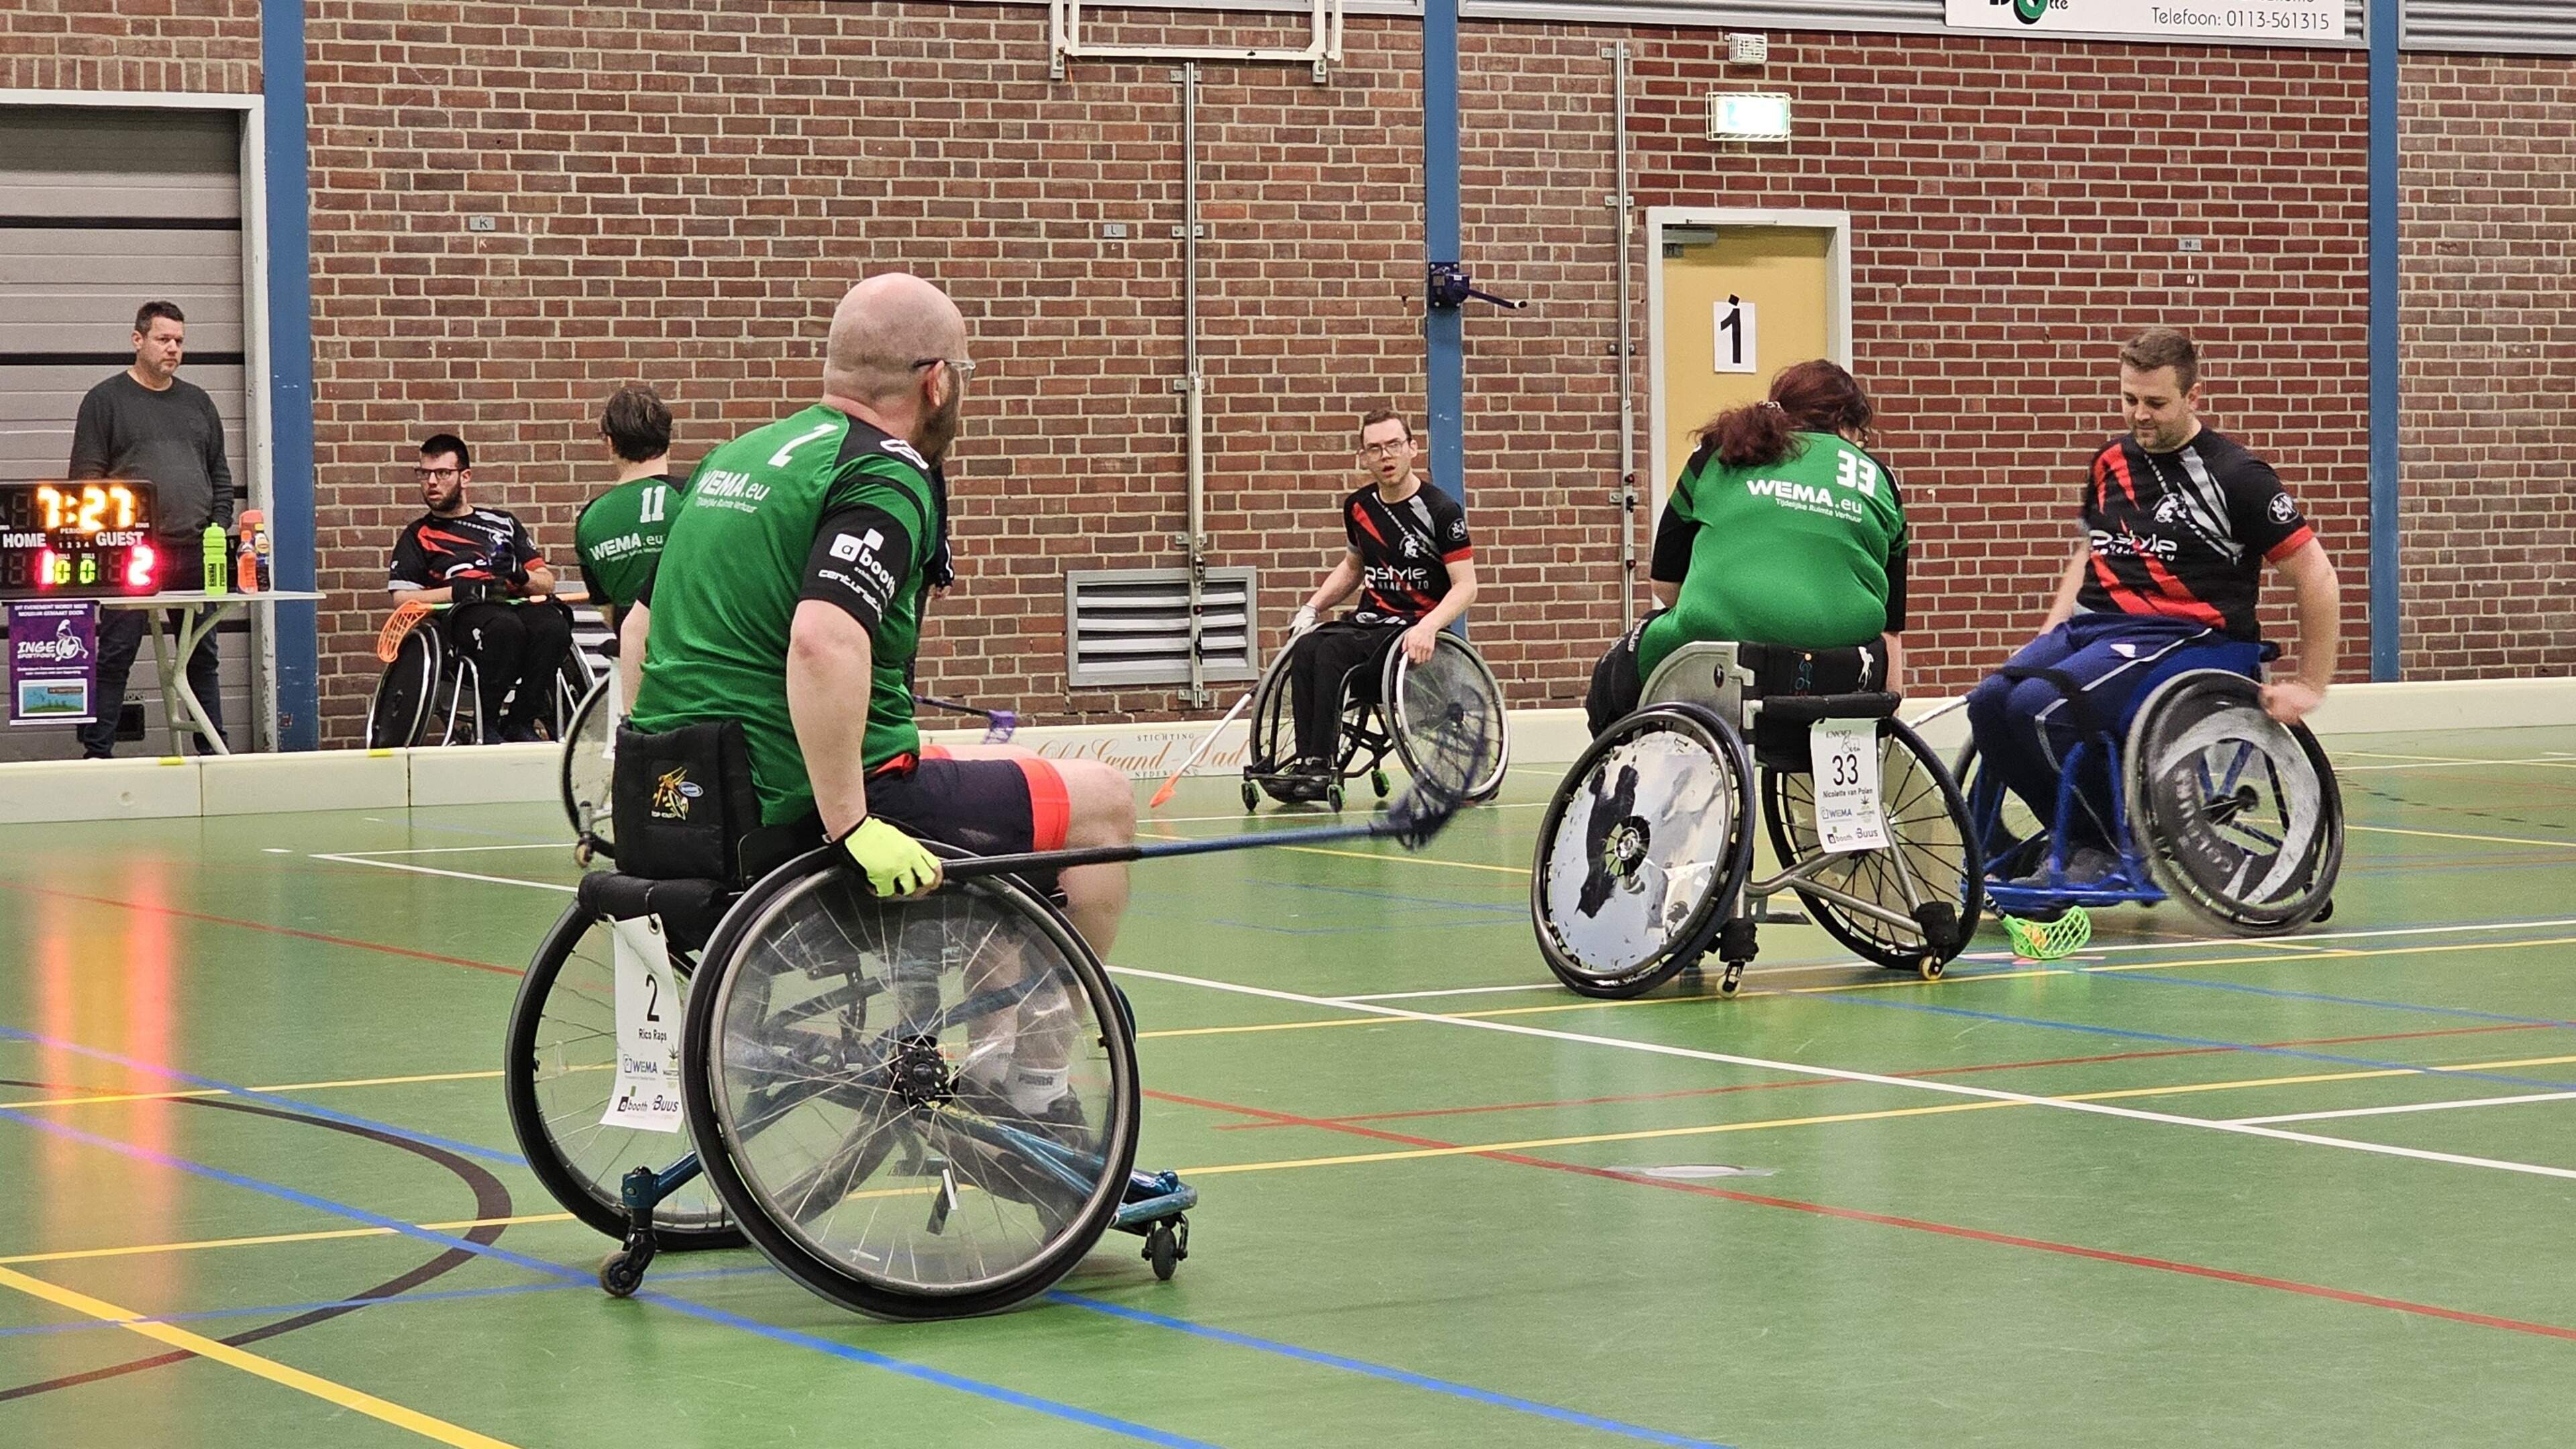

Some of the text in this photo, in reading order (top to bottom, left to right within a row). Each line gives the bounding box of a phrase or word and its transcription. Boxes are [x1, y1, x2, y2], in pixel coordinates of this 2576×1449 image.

[2151, 7, 2330, 30] Telefoon: 0113-561315
[479, 218, 488, 229] K
[1111, 225, 1117, 235] L
[1720, 308, 1741, 364] 1
[1836, 449, 1877, 497] 33
[37, 486, 132, 531] 7:27
[639, 485, 666, 523] 11
[1746, 479, 1862, 515] WEMA.eu
[3, 533, 47, 547] HOME
[95, 531, 144, 546] GUEST
[589, 533, 663, 561] WEMA.eu
[54, 559, 70, 584] 0
[79, 559, 95, 584] 0
[127, 545, 154, 586] 2
[17, 641, 56, 653] INGE
[1137, 733, 1194, 742] STICHTING
[1832, 753, 1859, 786] 33
[1829, 808, 1852, 818] WEMA
[646, 973, 660, 1022] 2
[638, 1028, 667, 1042] Rico Raps
[633, 1061, 658, 1073] WEMA
[652, 1094, 679, 1112] Buus
